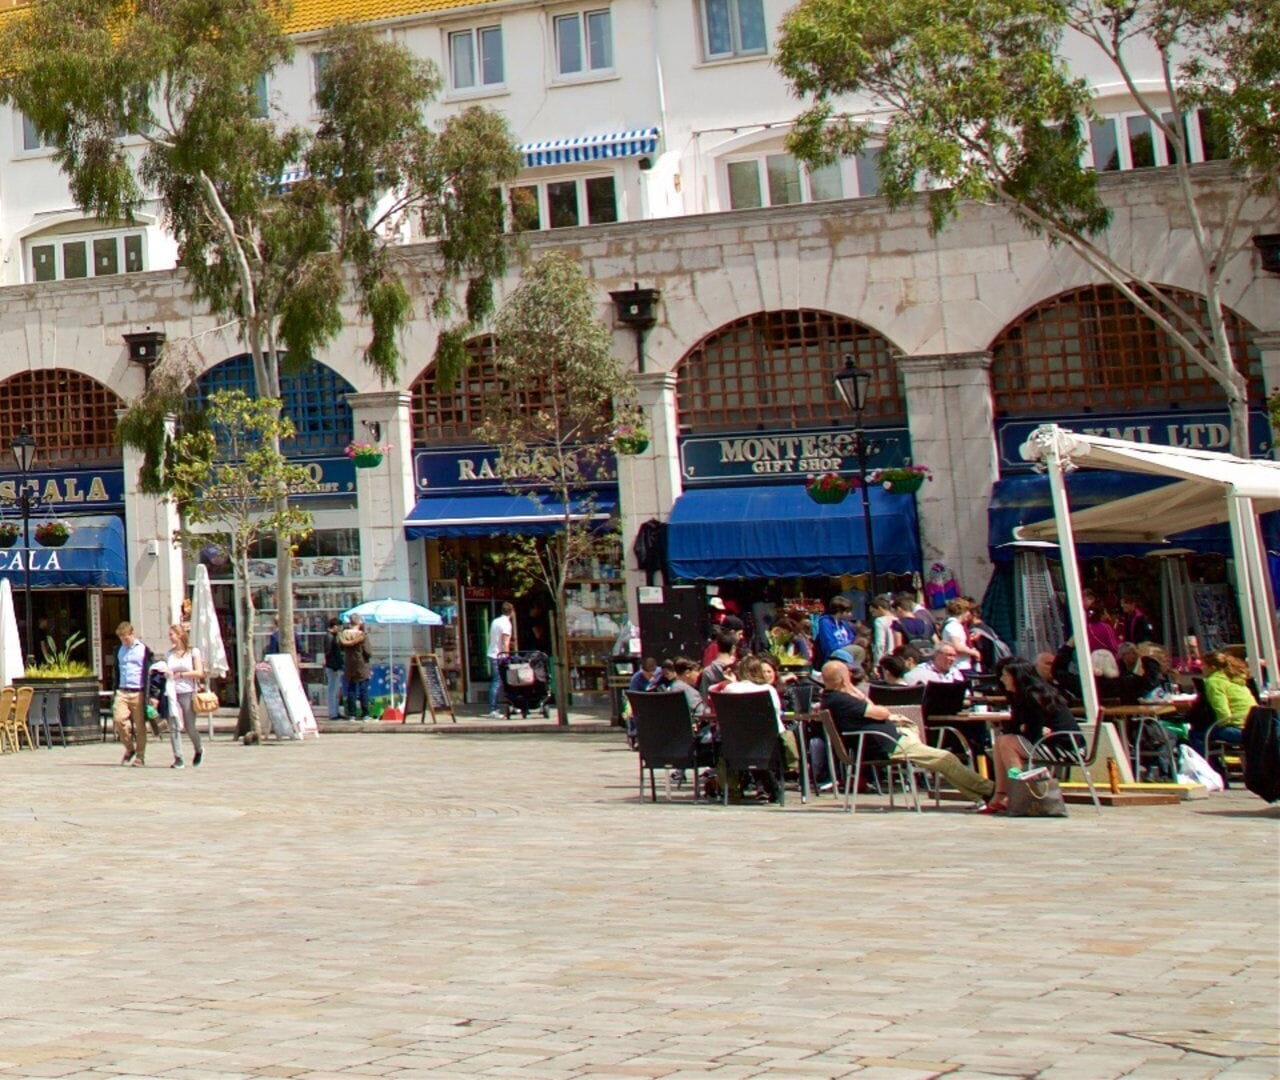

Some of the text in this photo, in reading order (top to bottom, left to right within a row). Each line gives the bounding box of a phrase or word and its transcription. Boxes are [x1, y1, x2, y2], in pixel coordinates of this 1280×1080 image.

[1167, 423, 1231, 449] LTD
[752, 457, 843, 474] GIFT SHOP
